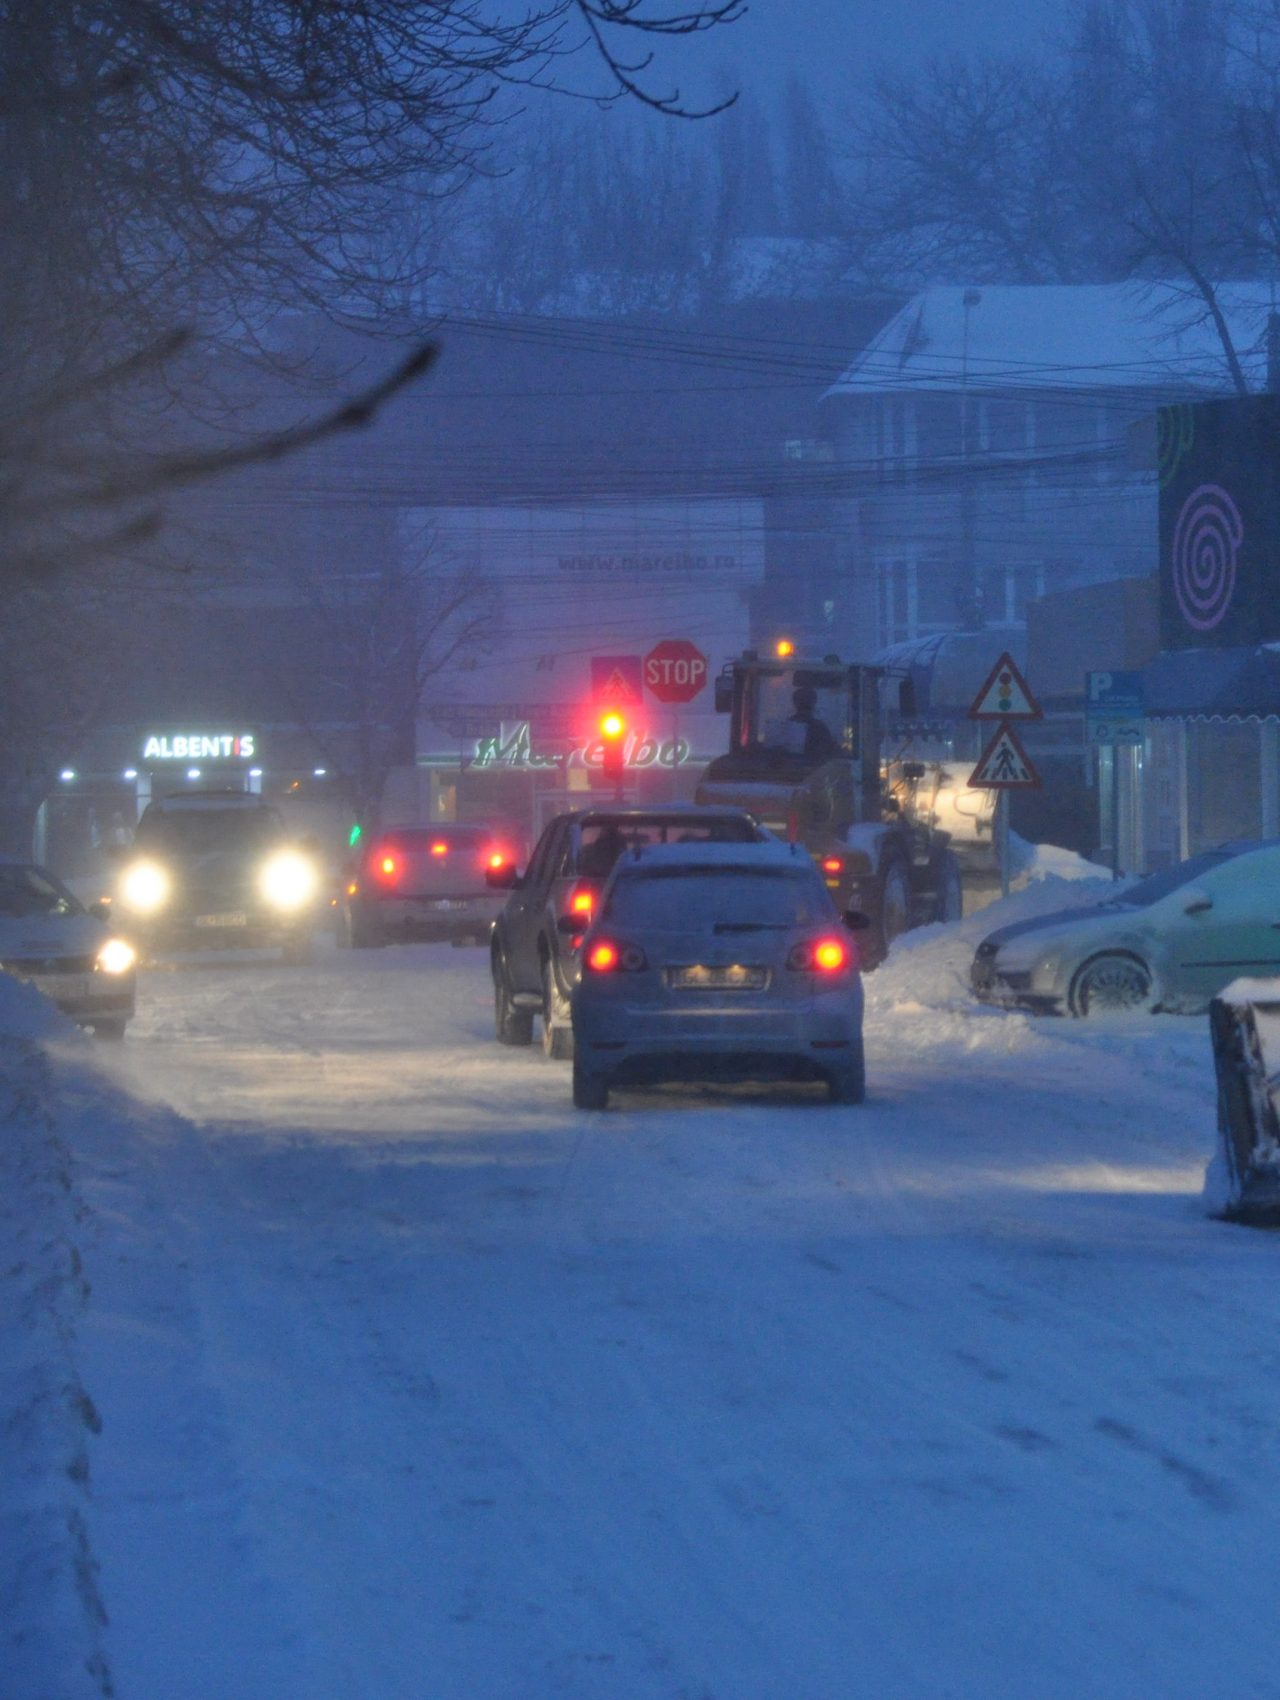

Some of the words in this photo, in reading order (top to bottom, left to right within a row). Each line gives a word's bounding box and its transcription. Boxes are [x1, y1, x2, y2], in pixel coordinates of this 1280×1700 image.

[647, 659, 705, 685] STOP
[143, 736, 255, 758] ALBENTIS
[472, 720, 690, 768] Mrebo
